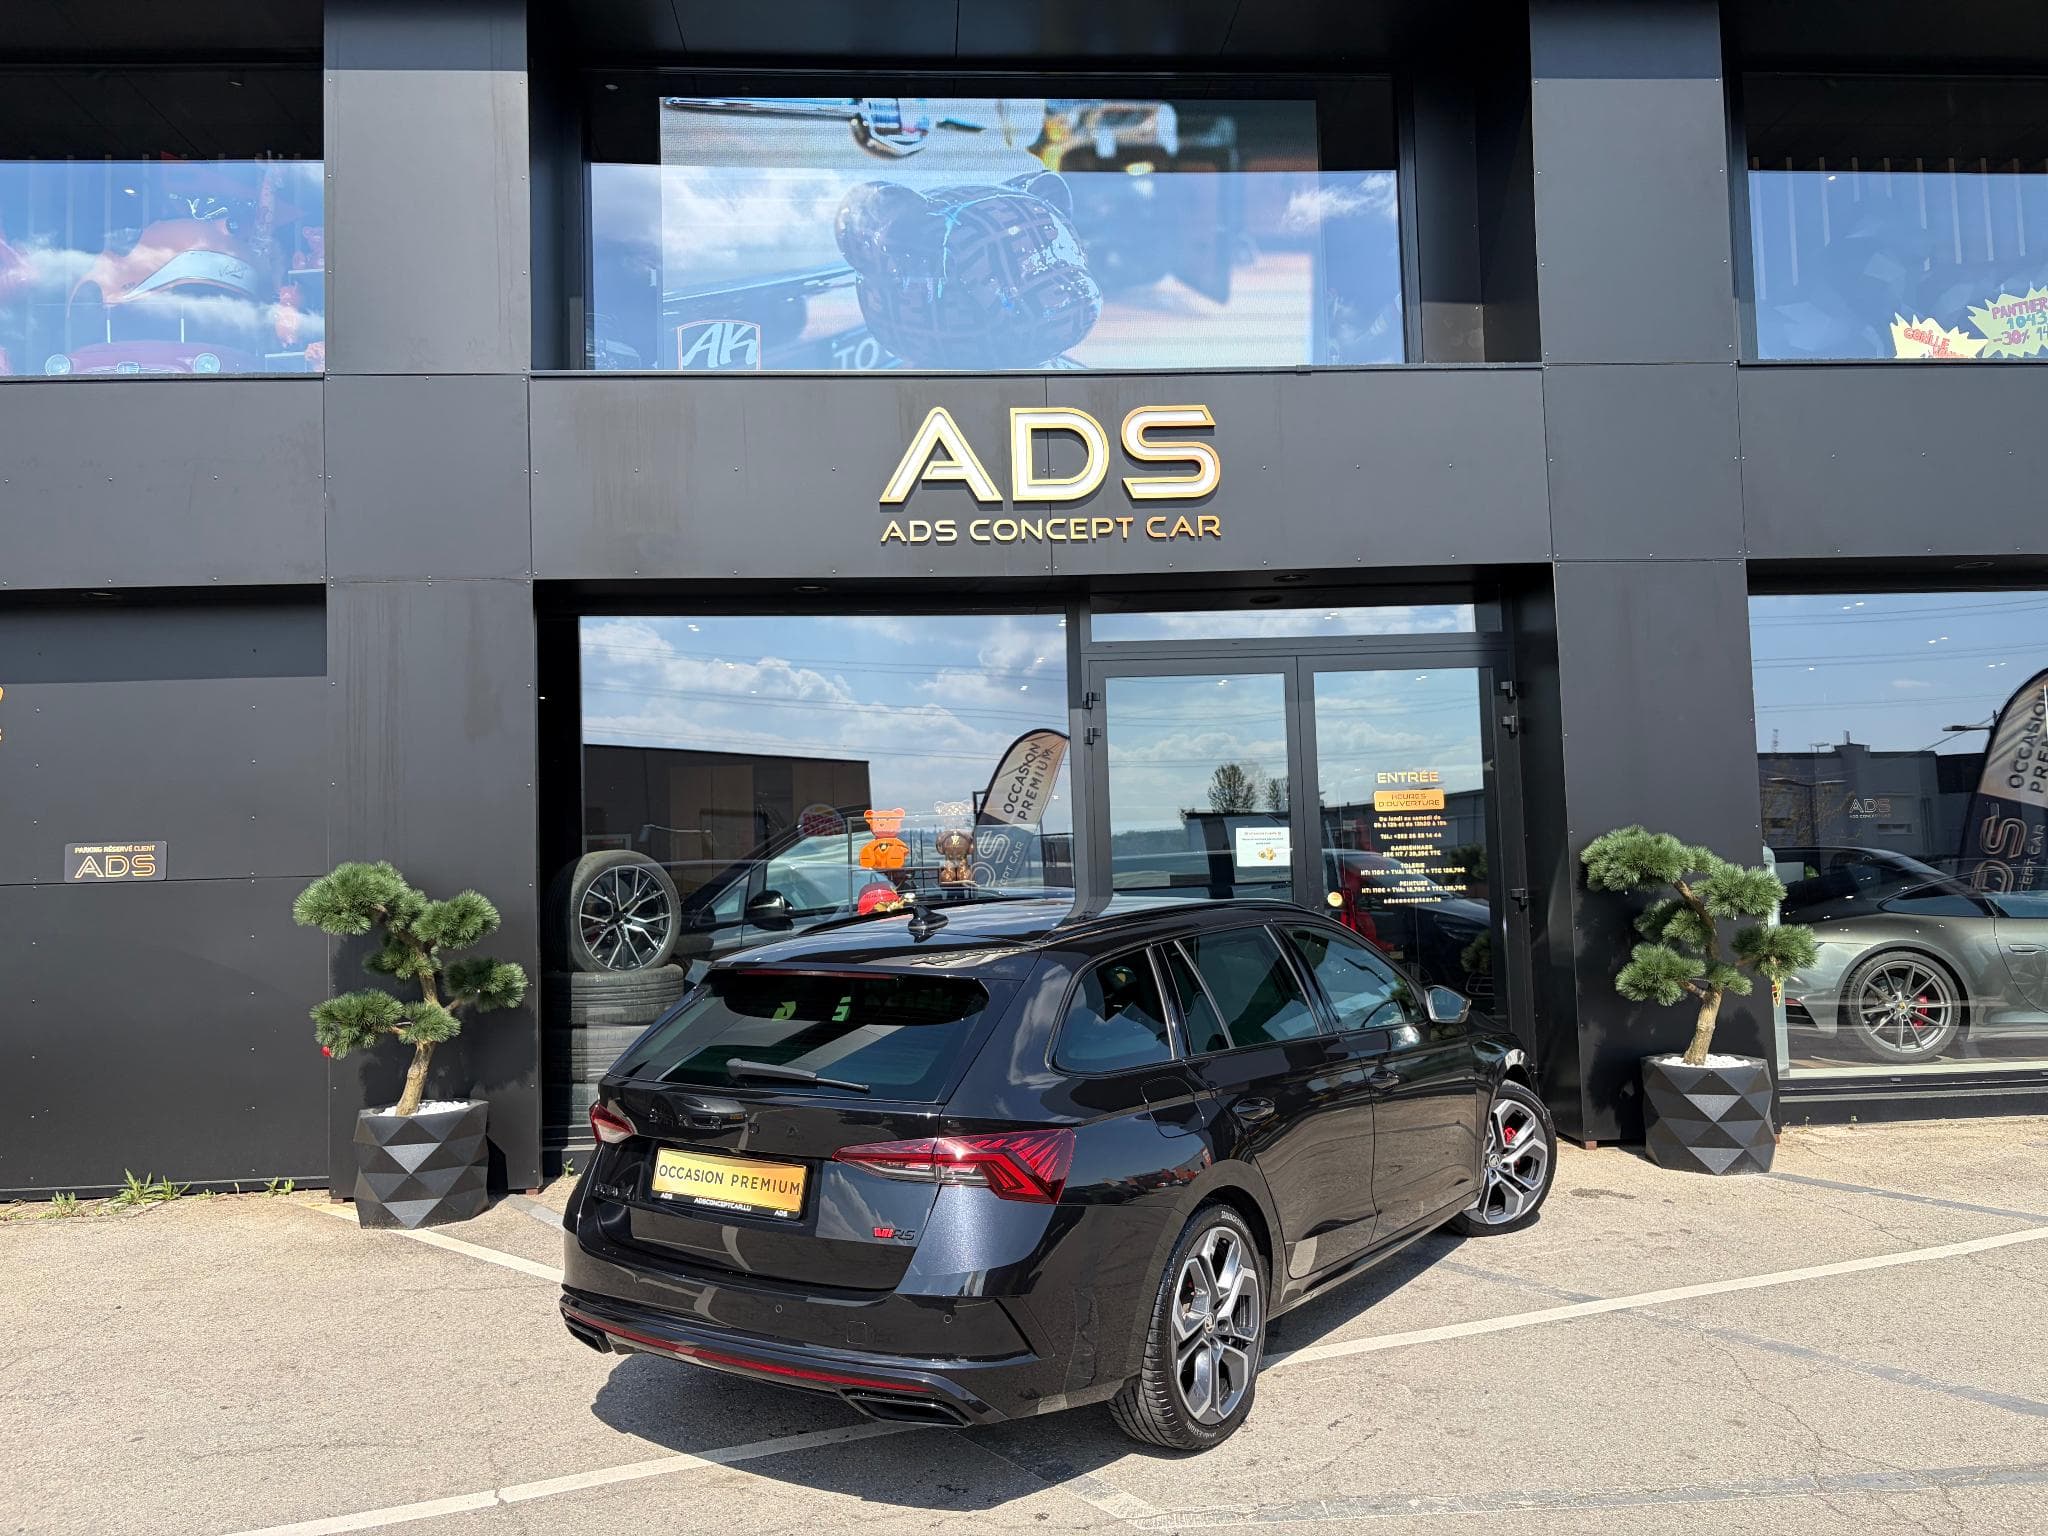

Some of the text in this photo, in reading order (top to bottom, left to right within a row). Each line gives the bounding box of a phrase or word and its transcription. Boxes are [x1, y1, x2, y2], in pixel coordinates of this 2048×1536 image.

[1992, 329, 2030, 346] -30%
[879, 404, 1221, 504] ADS
[880, 514, 1222, 544] ADS CONCEPT CAR
[1003, 743, 1041, 814] OCCASION
[1018, 748, 1055, 820] PREMIUM
[1377, 770, 1439, 784] ENTRÉE
[1010, 841, 1024, 863] CAR
[2030, 824, 2046, 855] CAR
[74, 854, 156, 878] ADS
[658, 1164, 800, 1195] OCCASION PREMIUM
[694, 1198, 752, 1212] ADSCONCEPTCAR.LU
